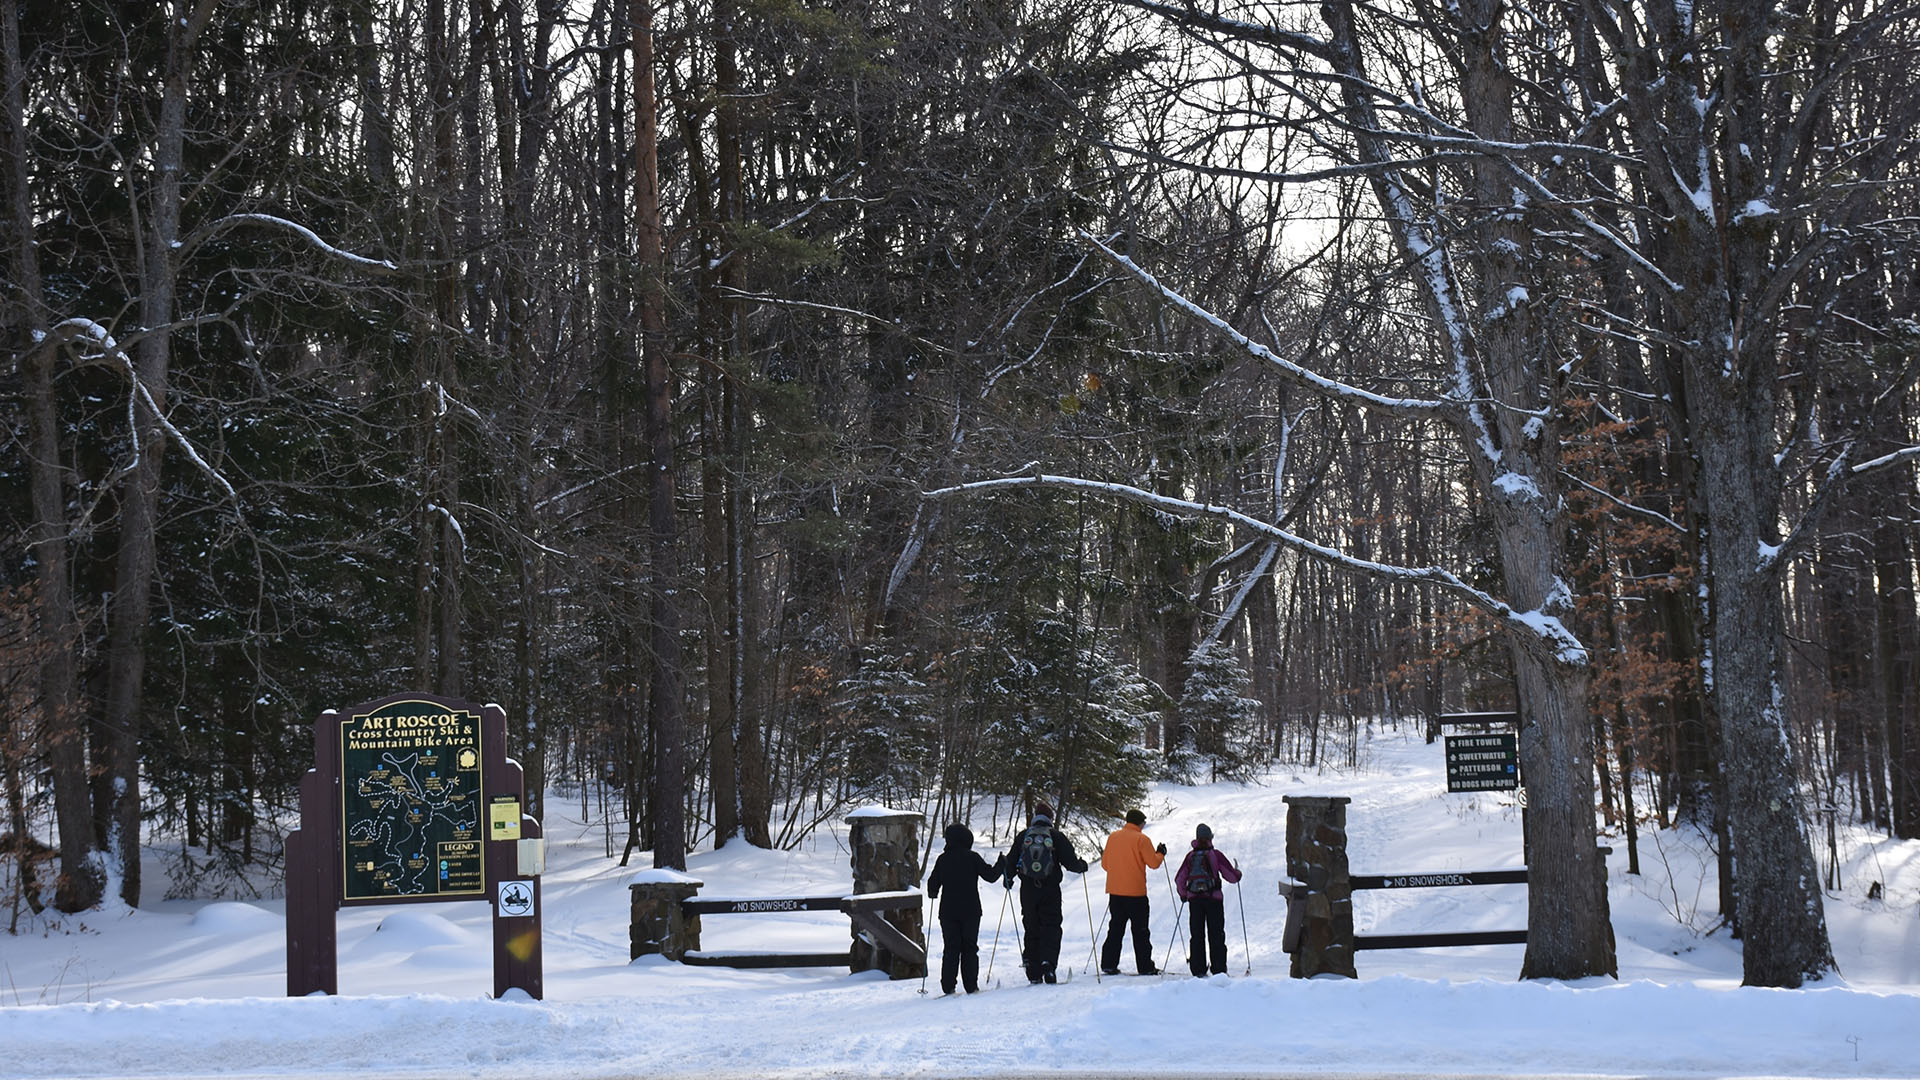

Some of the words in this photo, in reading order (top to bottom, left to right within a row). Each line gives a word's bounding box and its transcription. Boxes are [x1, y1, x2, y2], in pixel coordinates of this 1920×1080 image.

[362, 717, 394, 729] ART
[397, 714, 460, 728] ROSCOE
[349, 729, 382, 739] Cross
[385, 728, 436, 738] Country
[440, 725, 459, 736] Ski
[463, 725, 473, 735] &
[349, 738, 411, 750] Mountain
[415, 737, 442, 747] Bike
[445, 736, 473, 746] Area
[1458, 739, 1474, 747] FIRE
[1476, 738, 1502, 746] TOWER
[1458, 752, 1506, 761] SWEETWATER
[1459, 764, 1502, 773] PATTERSON
[1451, 780, 1461, 789] NO
[1461, 780, 1480, 788] DOGS
[444, 843, 474, 851] LEGEND
[1394, 877, 1407, 887] NO
[737, 902, 749, 912] NO
